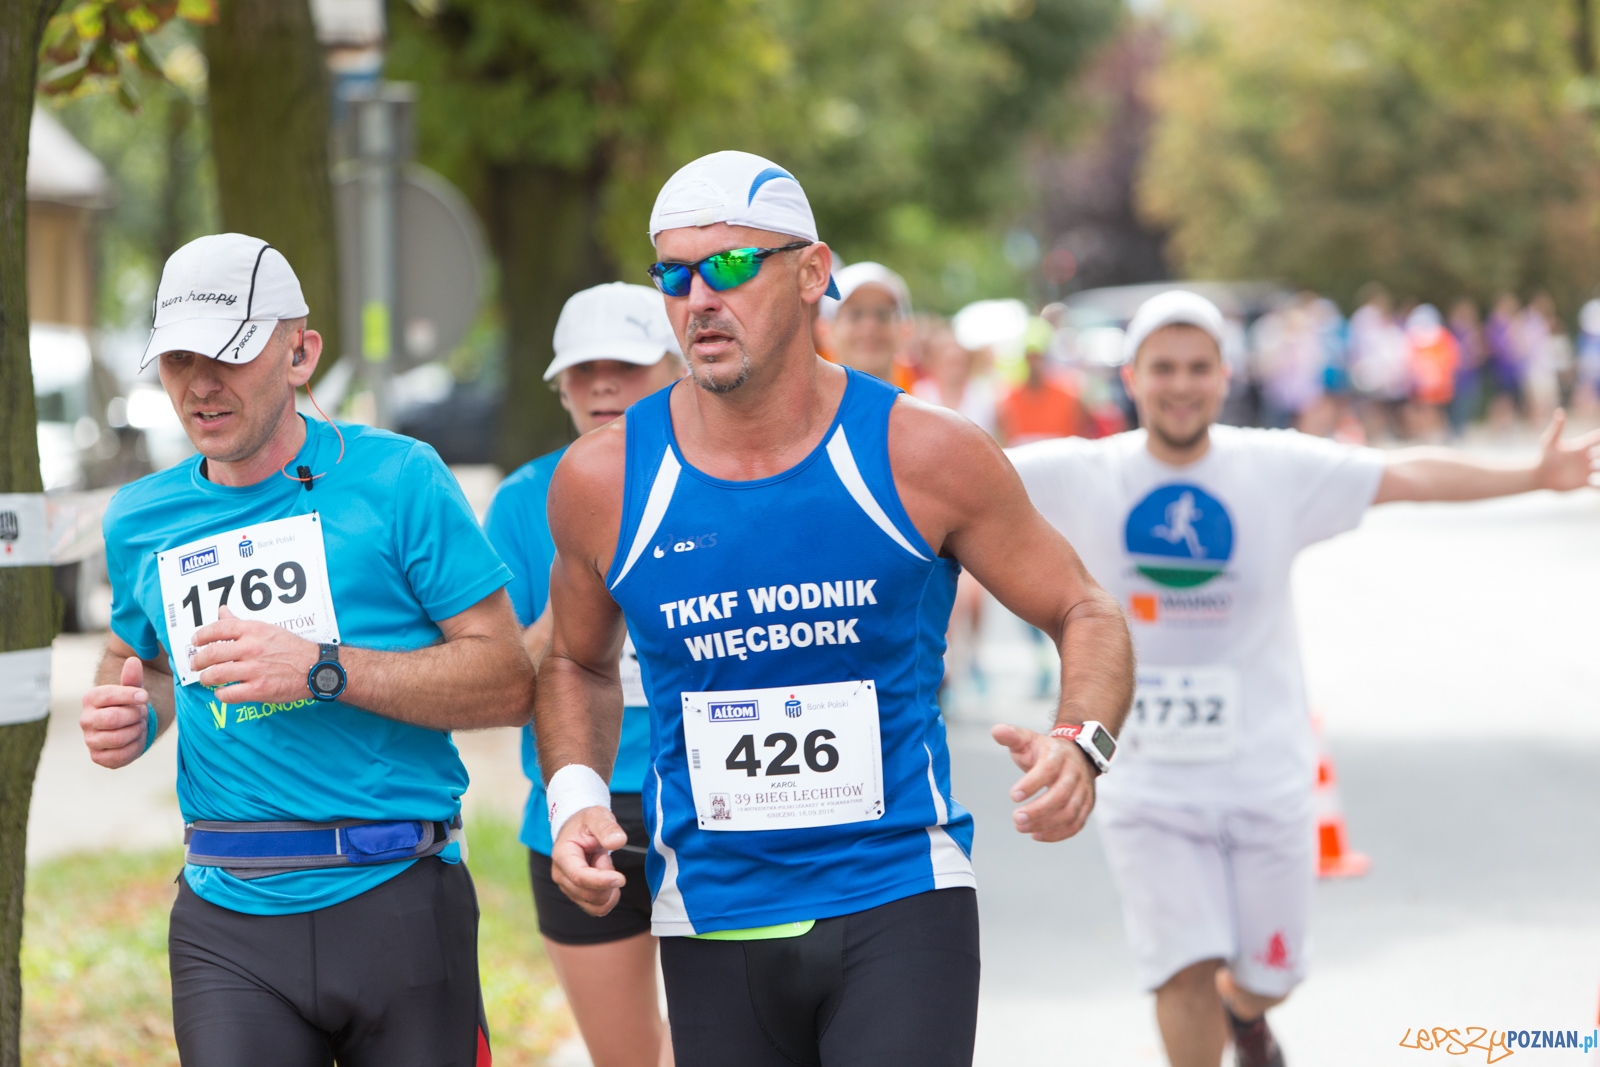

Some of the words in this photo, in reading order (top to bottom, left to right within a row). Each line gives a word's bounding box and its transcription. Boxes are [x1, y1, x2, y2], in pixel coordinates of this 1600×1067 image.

[160, 295, 183, 310] run
[185, 290, 238, 306] happy
[238, 324, 258, 349] BROOKS
[257, 540, 275, 549] Bank
[276, 534, 296, 542] Polski
[182, 561, 307, 628] 1769
[659, 590, 739, 629] TKKF
[747, 578, 878, 615] WODNIK
[684, 617, 861, 662] WIĘCBORK
[806, 702, 826, 711] Bank
[827, 699, 850, 709] Polski
[1135, 696, 1225, 726] 1732
[725, 728, 840, 777] 426
[734, 793, 751, 806] 39
[755, 791, 788, 804] BIEG
[793, 782, 864, 802] LECHITÓW
[770, 781, 798, 789] KAROL
[799, 808, 835, 817] 18.09.2016
